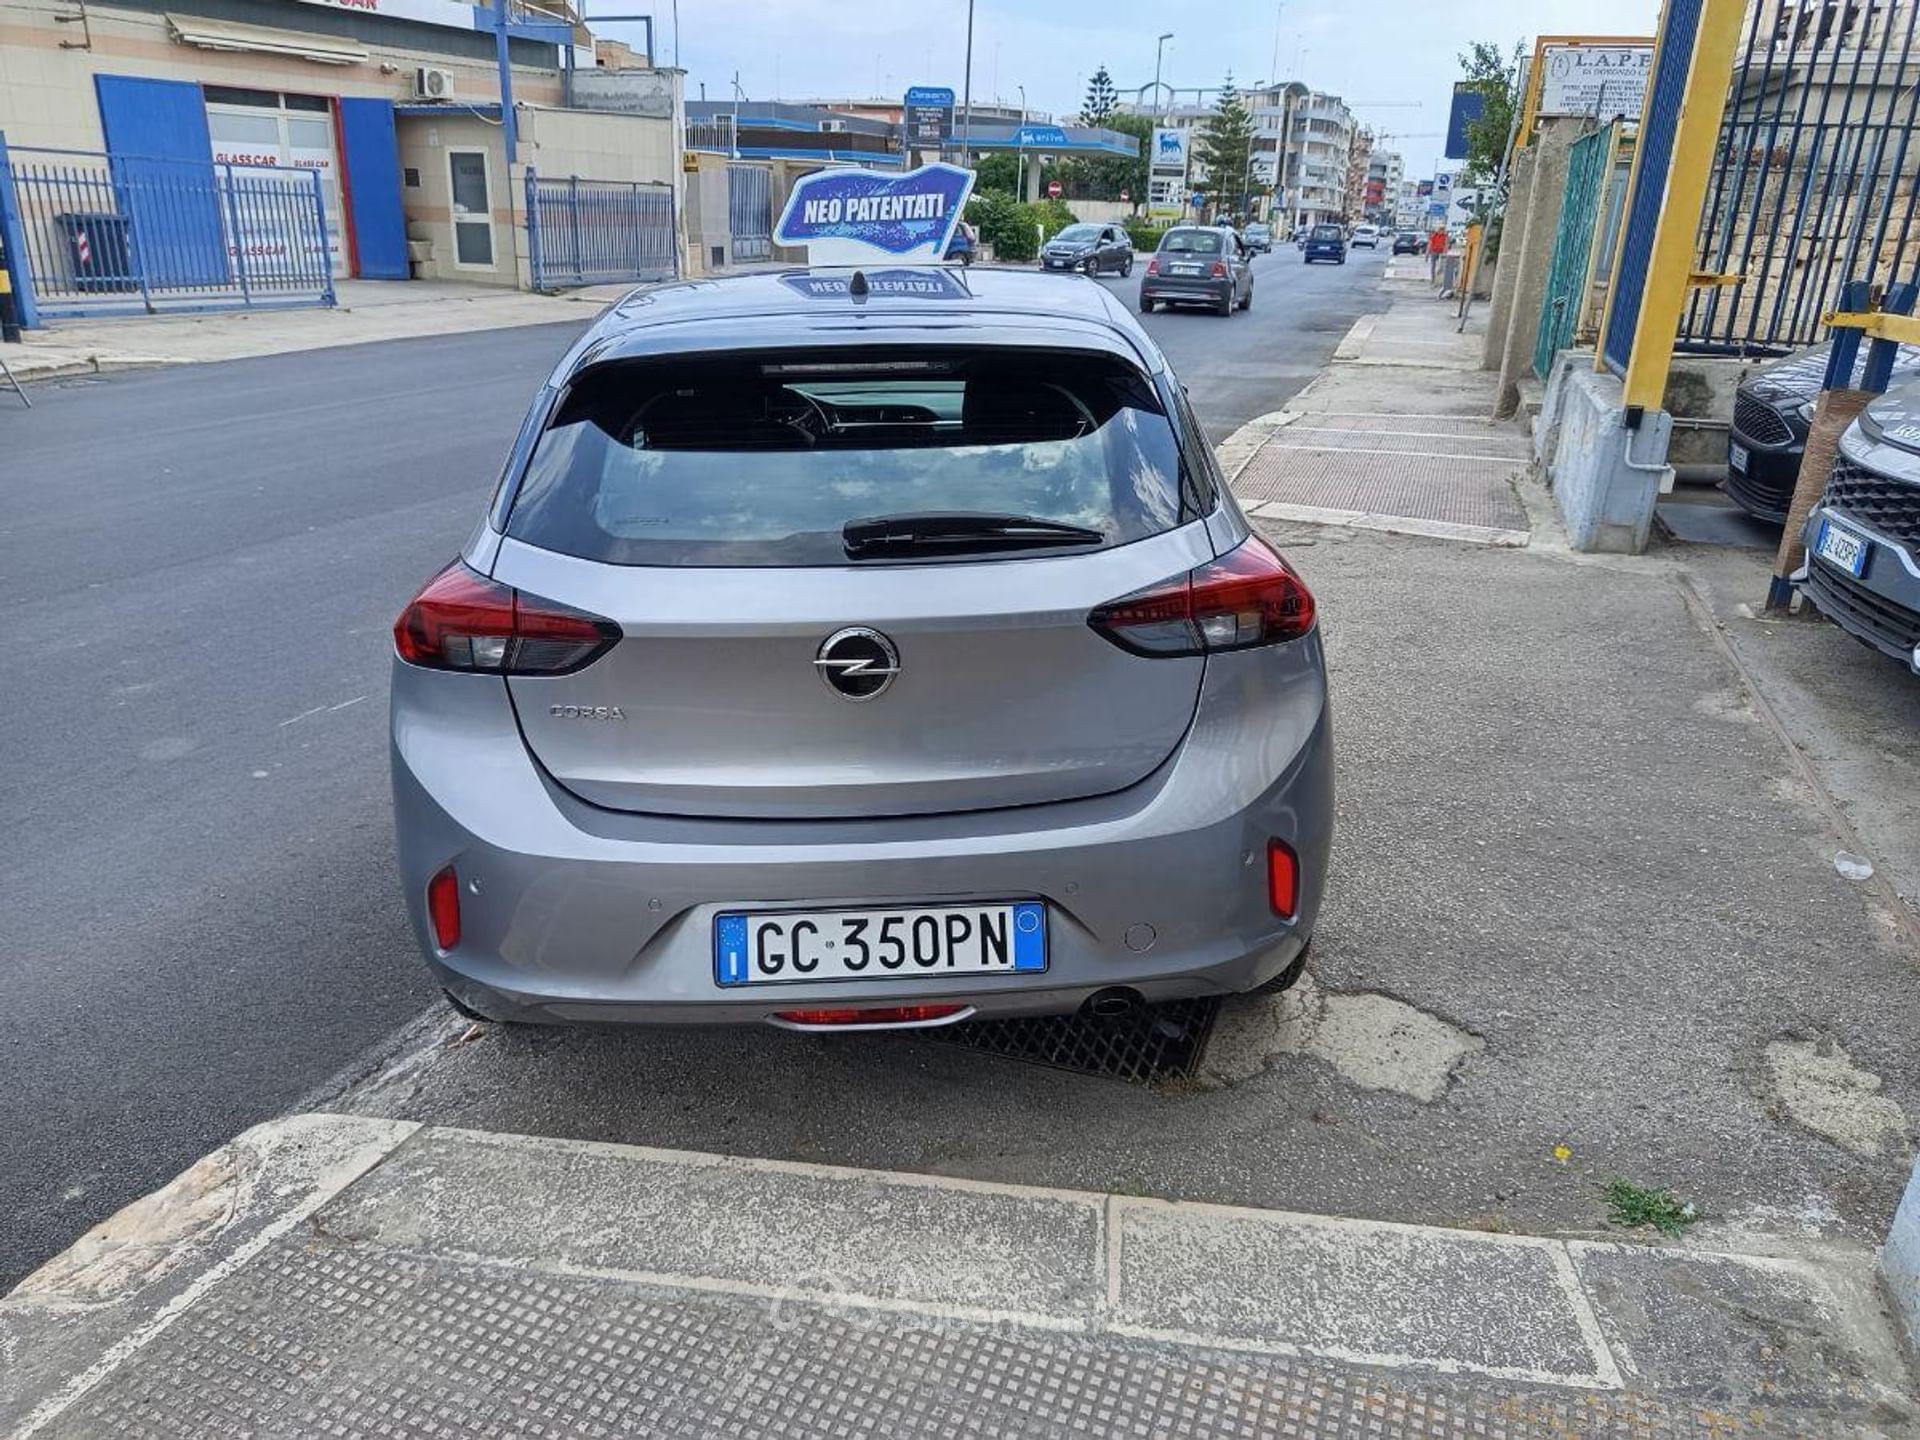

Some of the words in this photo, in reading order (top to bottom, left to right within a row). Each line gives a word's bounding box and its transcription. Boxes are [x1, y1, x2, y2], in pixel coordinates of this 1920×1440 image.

[216, 153, 252, 165] GLASS
[253, 155, 277, 167] CAR
[803, 199, 841, 224] NEO
[845, 193, 945, 223] PATENTATI
[550, 704, 628, 720] CORSA
[756, 921, 819, 976] GC
[841, 911, 1009, 972] 350PN
